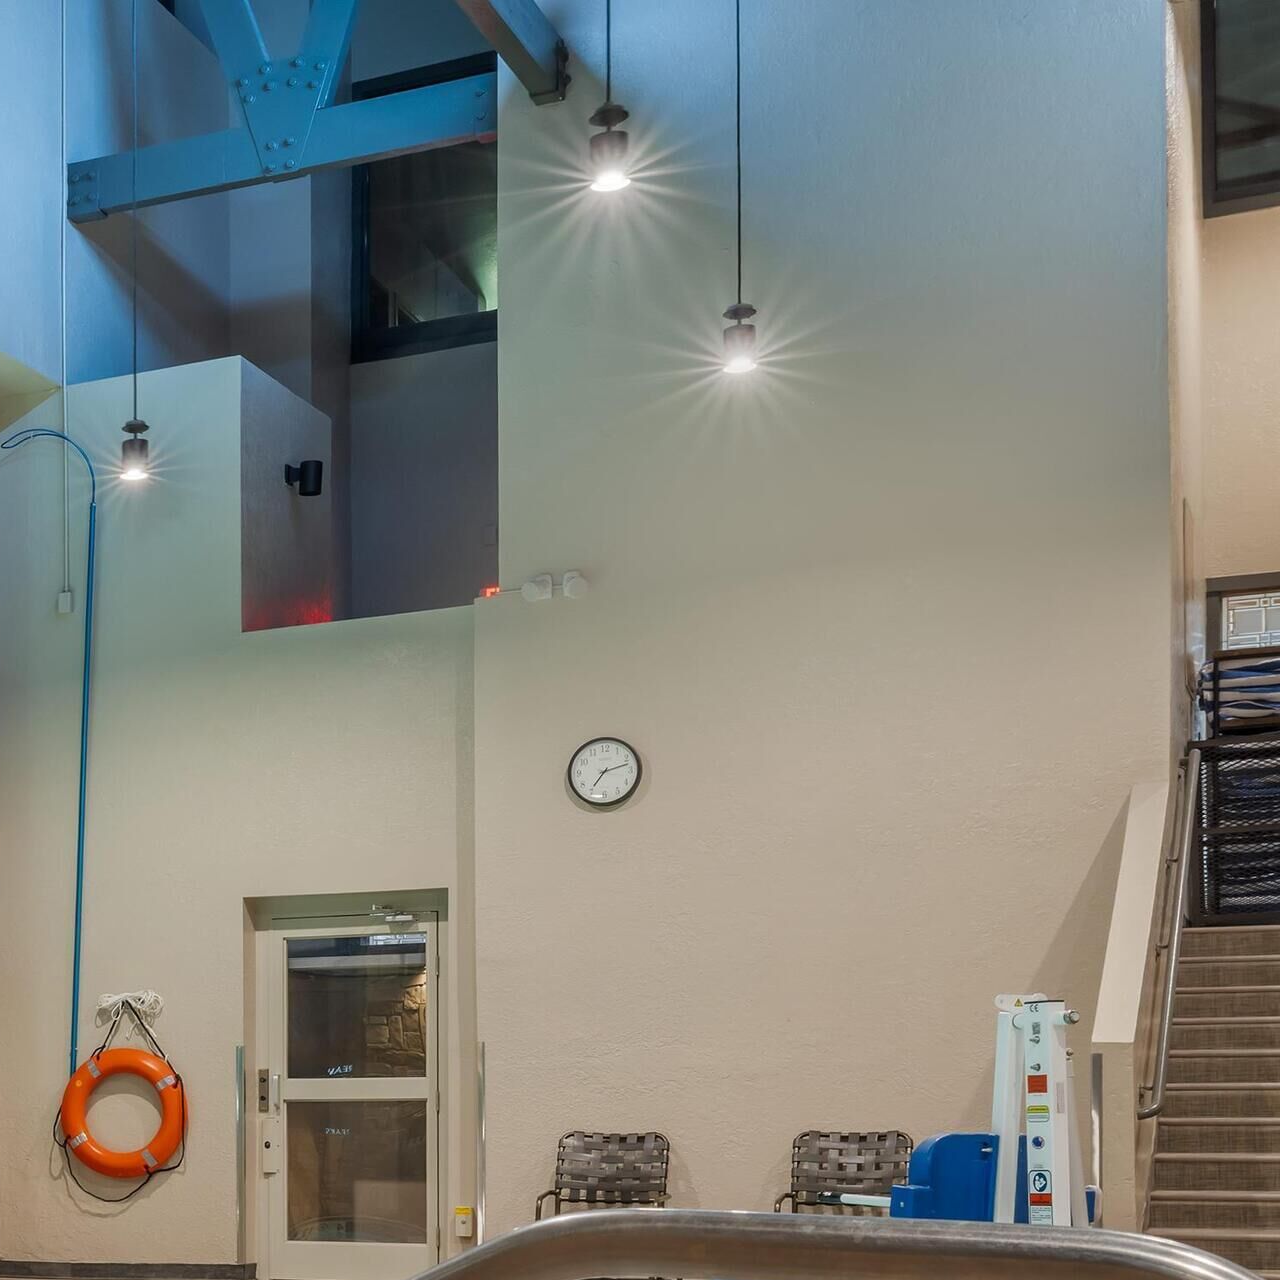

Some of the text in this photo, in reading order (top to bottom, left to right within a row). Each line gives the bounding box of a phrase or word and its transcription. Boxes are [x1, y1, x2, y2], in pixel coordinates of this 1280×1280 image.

[589, 748, 597, 757] 11
[601, 744, 610, 753] 12
[580, 758, 589, 766] 10
